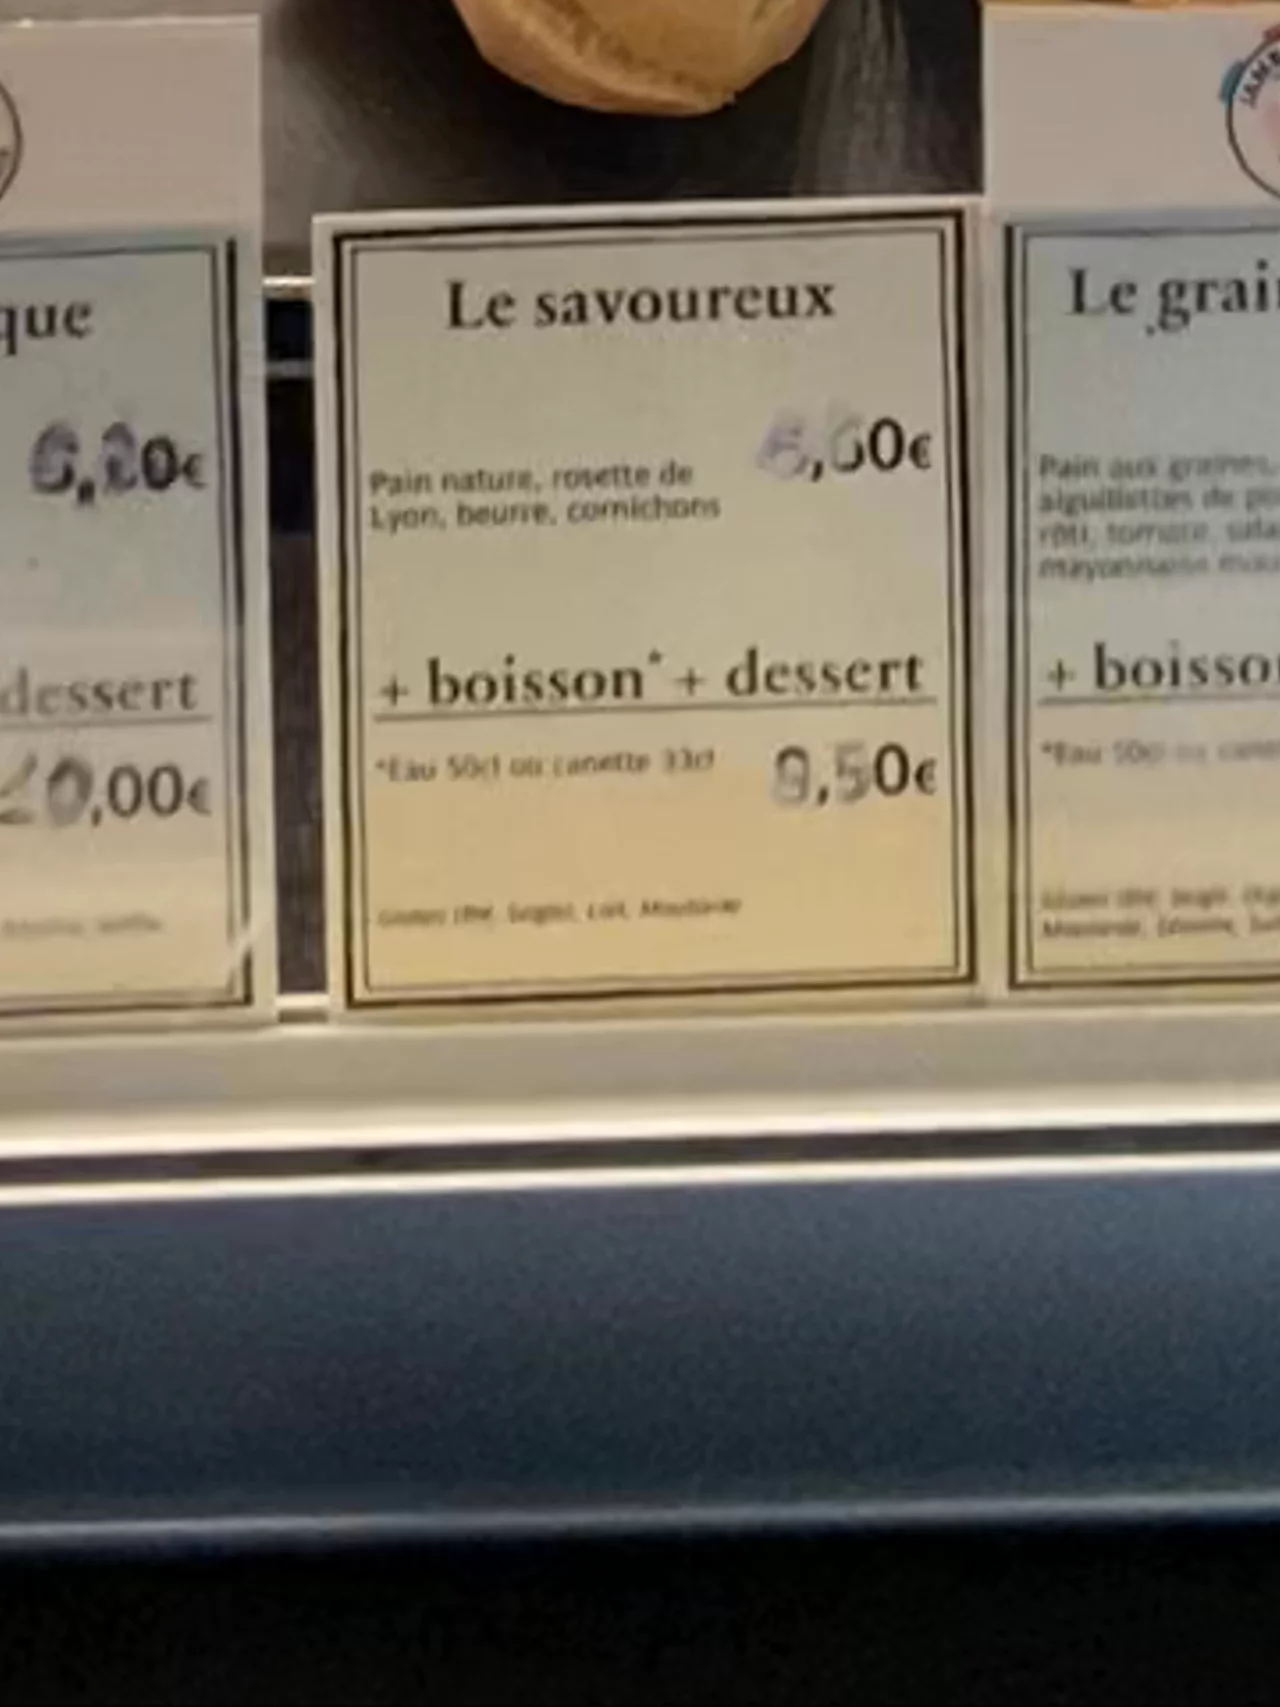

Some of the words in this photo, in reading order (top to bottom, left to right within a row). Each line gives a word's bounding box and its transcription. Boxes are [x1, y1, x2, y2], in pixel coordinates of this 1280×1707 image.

[447, 280, 516, 329] Le
[534, 281, 837, 328] savoureux
[1068, 268, 1136, 316] Le
[370, 468, 433, 496] Pain
[442, 468, 544, 494] nature,
[553, 463, 651, 491] rosette
[660, 458, 694, 487] de
[370, 504, 447, 536] Lyon,
[458, 500, 557, 527] beurre,
[567, 494, 721, 522] cornichons
[380, 679, 408, 707] +
[680, 668, 704, 696] +
[725, 646, 924, 697] dessert
[1048, 661, 1075, 691] +
